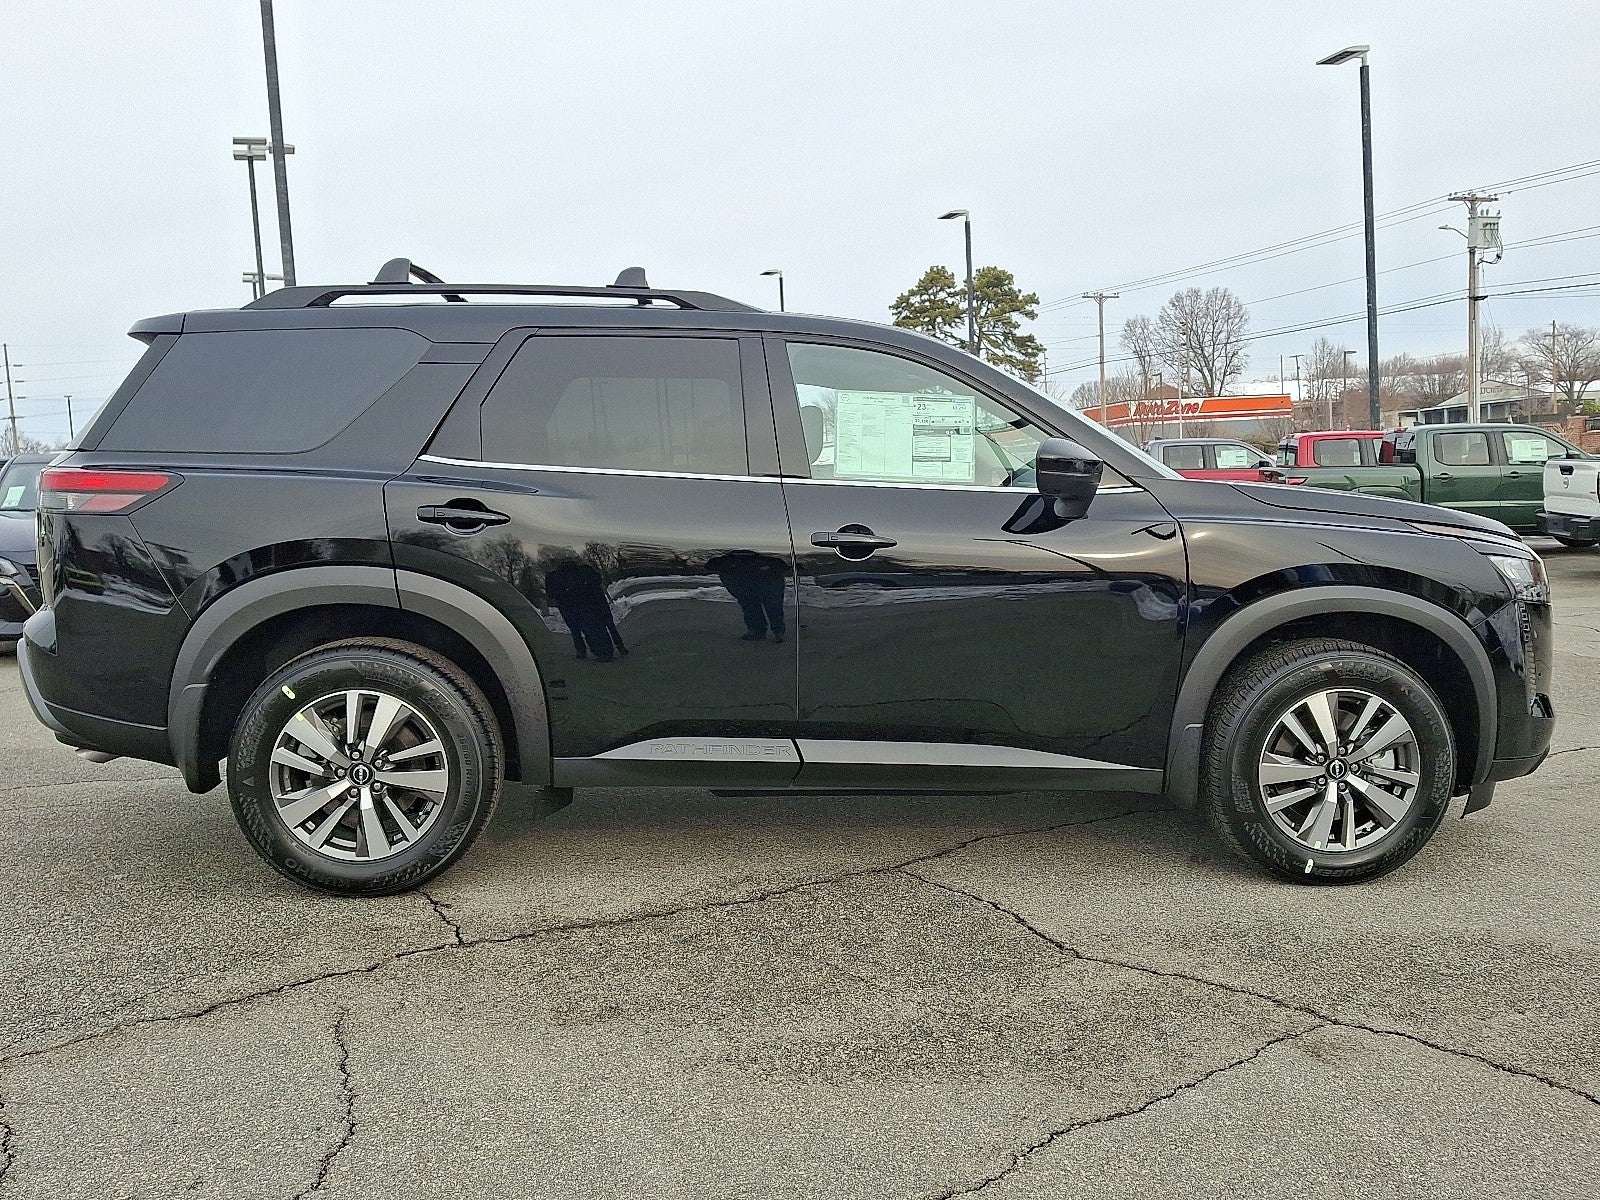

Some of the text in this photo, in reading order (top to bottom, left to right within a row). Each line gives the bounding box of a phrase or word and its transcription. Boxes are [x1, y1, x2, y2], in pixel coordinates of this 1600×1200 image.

[917, 403, 927, 411] 23
[1133, 400, 1200, 415] AutoZone
[649, 743, 791, 756] PATHFINDER
